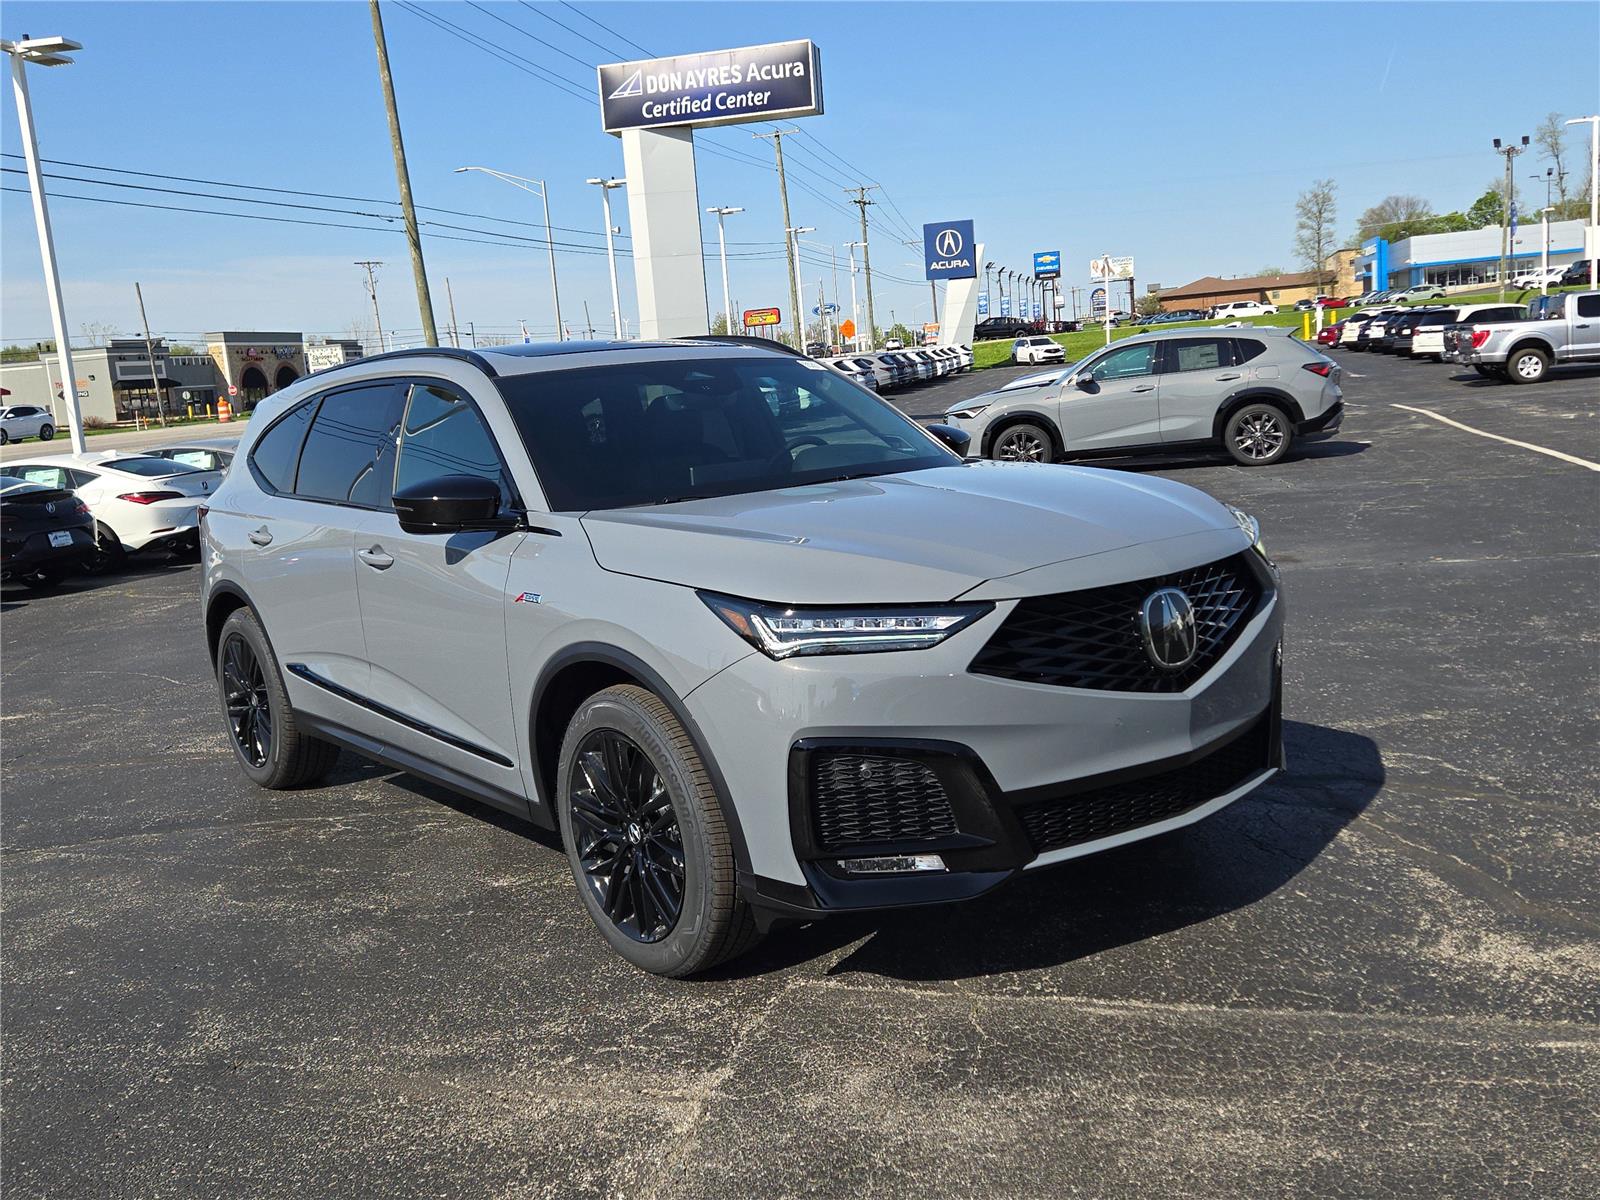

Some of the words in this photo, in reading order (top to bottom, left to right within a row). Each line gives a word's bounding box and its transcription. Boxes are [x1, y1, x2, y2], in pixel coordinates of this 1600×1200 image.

[646, 72, 682, 94] DON
[685, 65, 742, 89] AYRES
[746, 61, 805, 82] Acura
[642, 96, 711, 118] Certified
[715, 90, 771, 110] Center
[930, 259, 970, 270] ACURA
